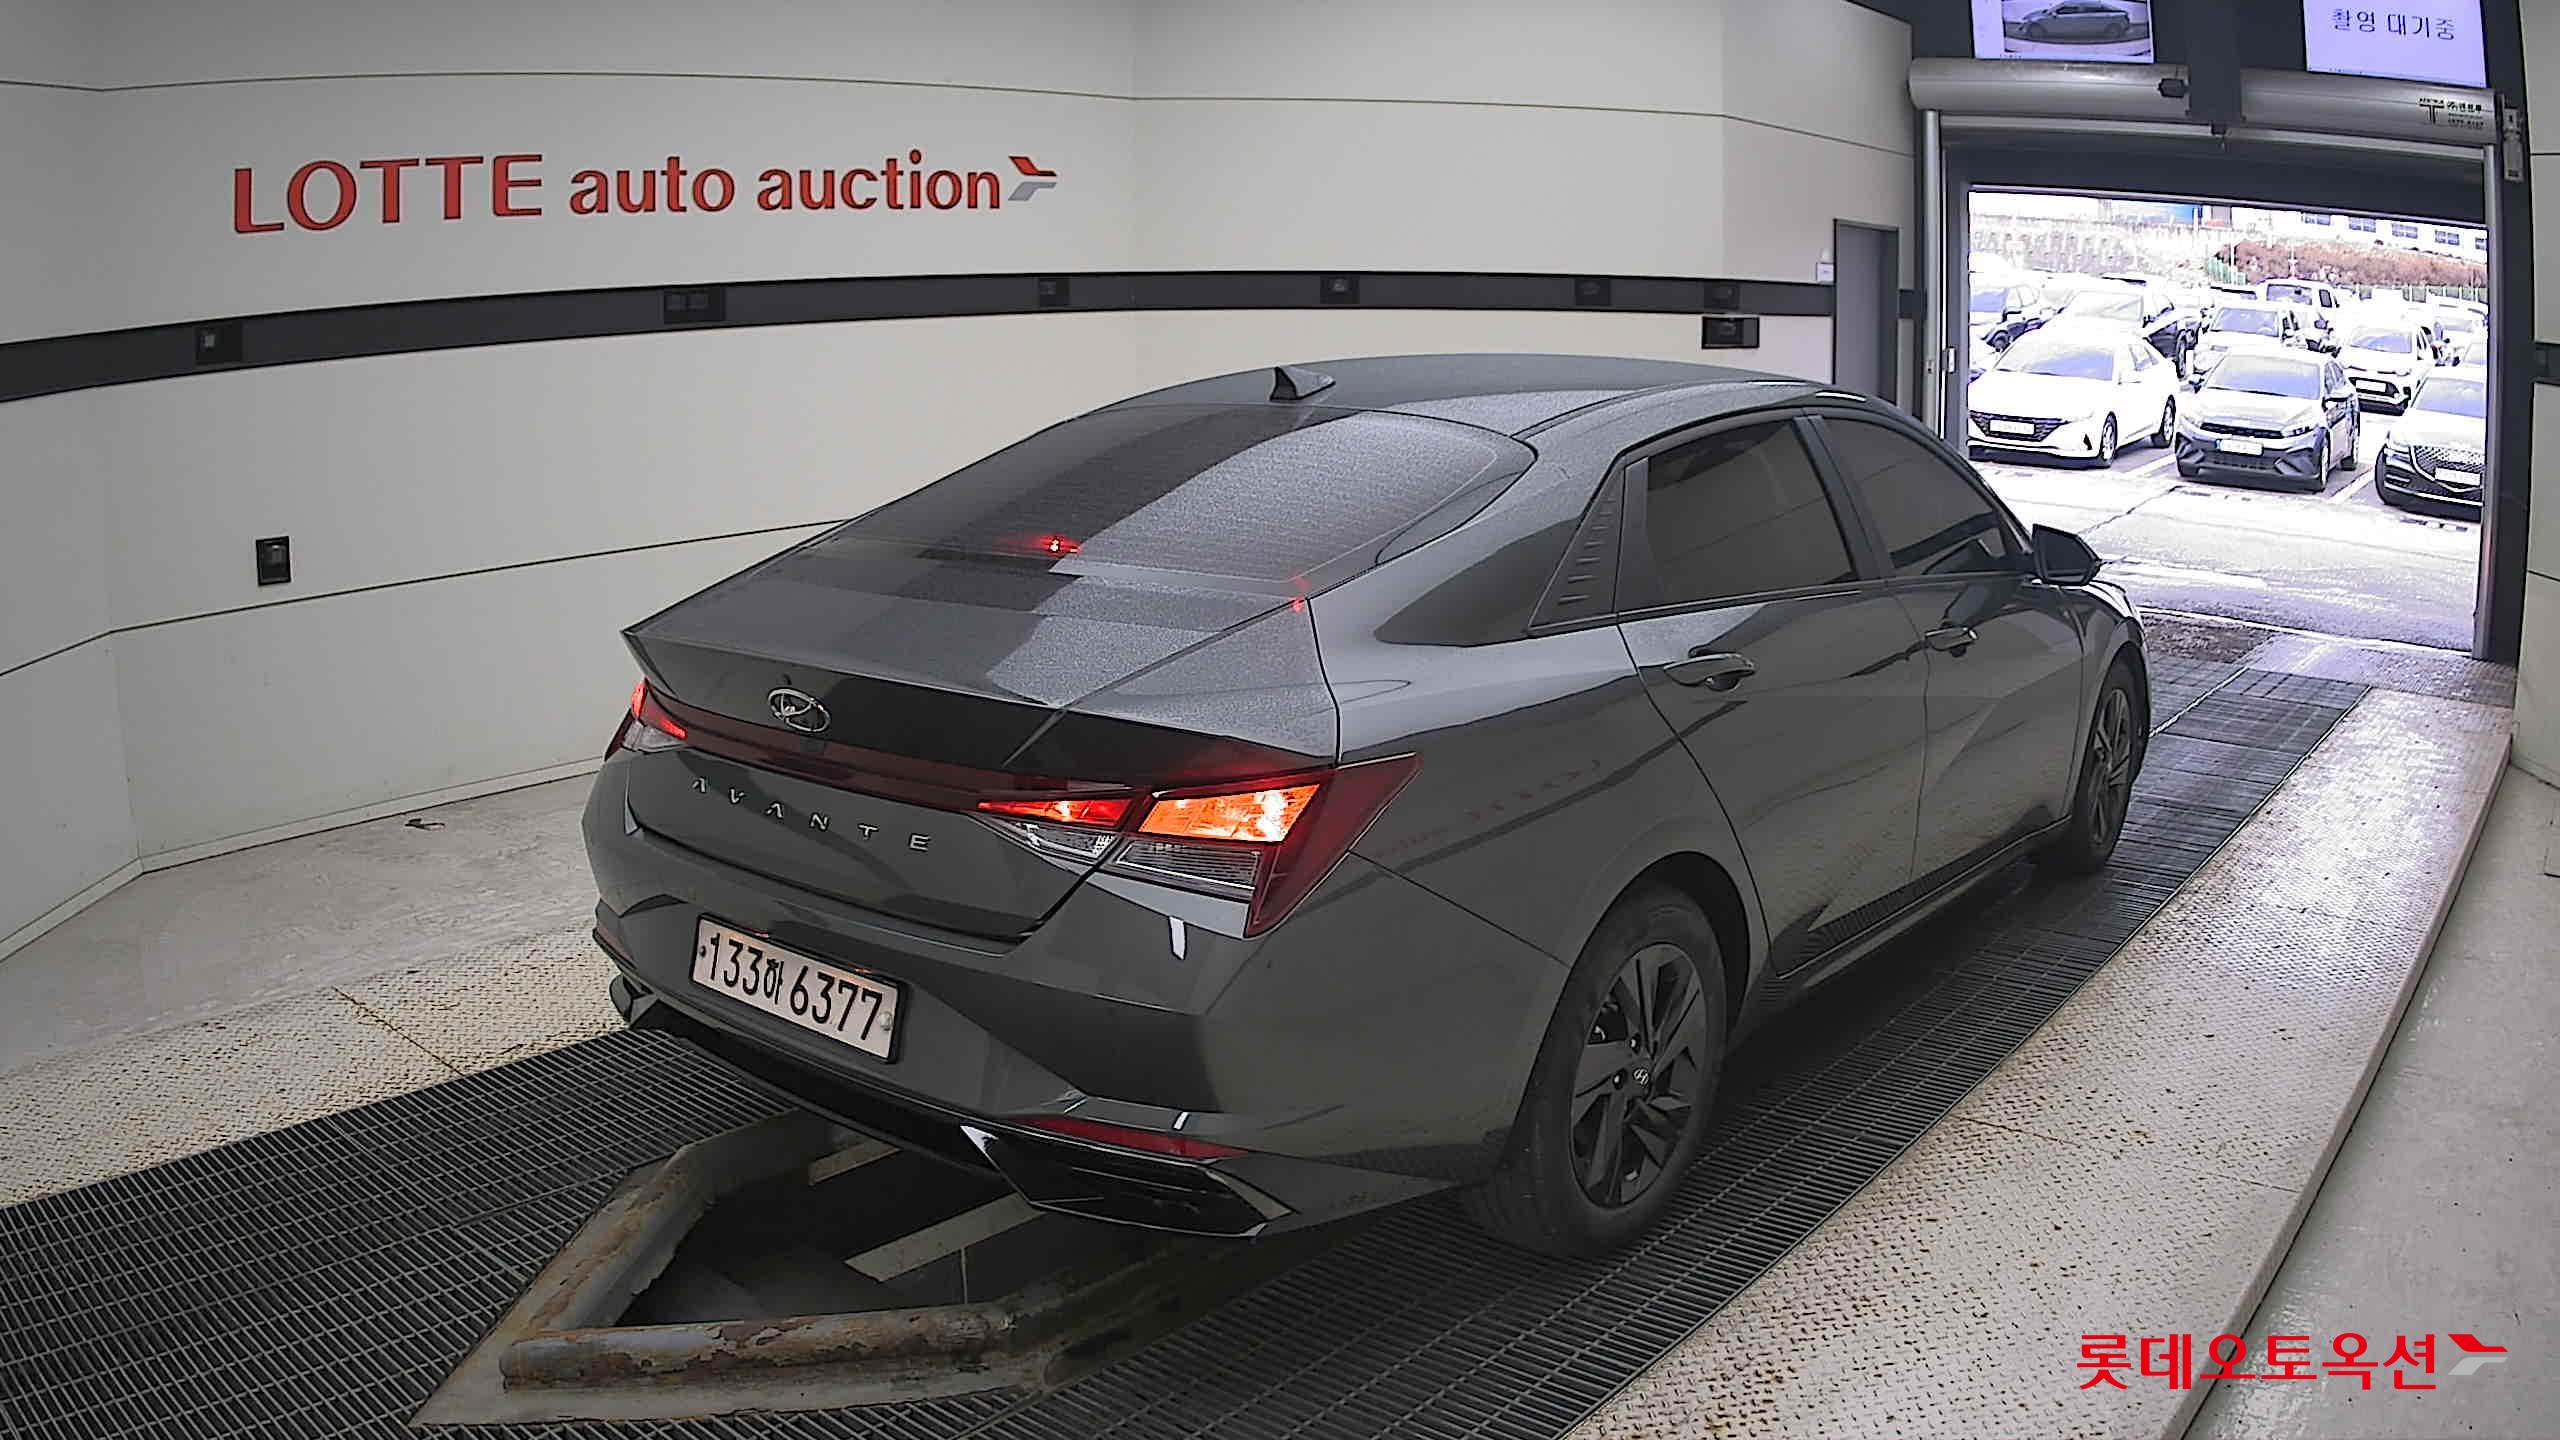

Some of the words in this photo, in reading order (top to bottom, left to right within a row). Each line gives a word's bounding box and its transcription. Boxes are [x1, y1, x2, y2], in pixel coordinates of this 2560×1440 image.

[2331, 8, 2375, 32] 촬영
[2387, 13, 2456, 41] 대기중
[235, 154, 543, 234] LOTTE
[569, 157, 735, 214] auto
[757, 149, 1001, 211] auction
[691, 775, 932, 852] AVANTE
[788, 964, 884, 1042] 6377
